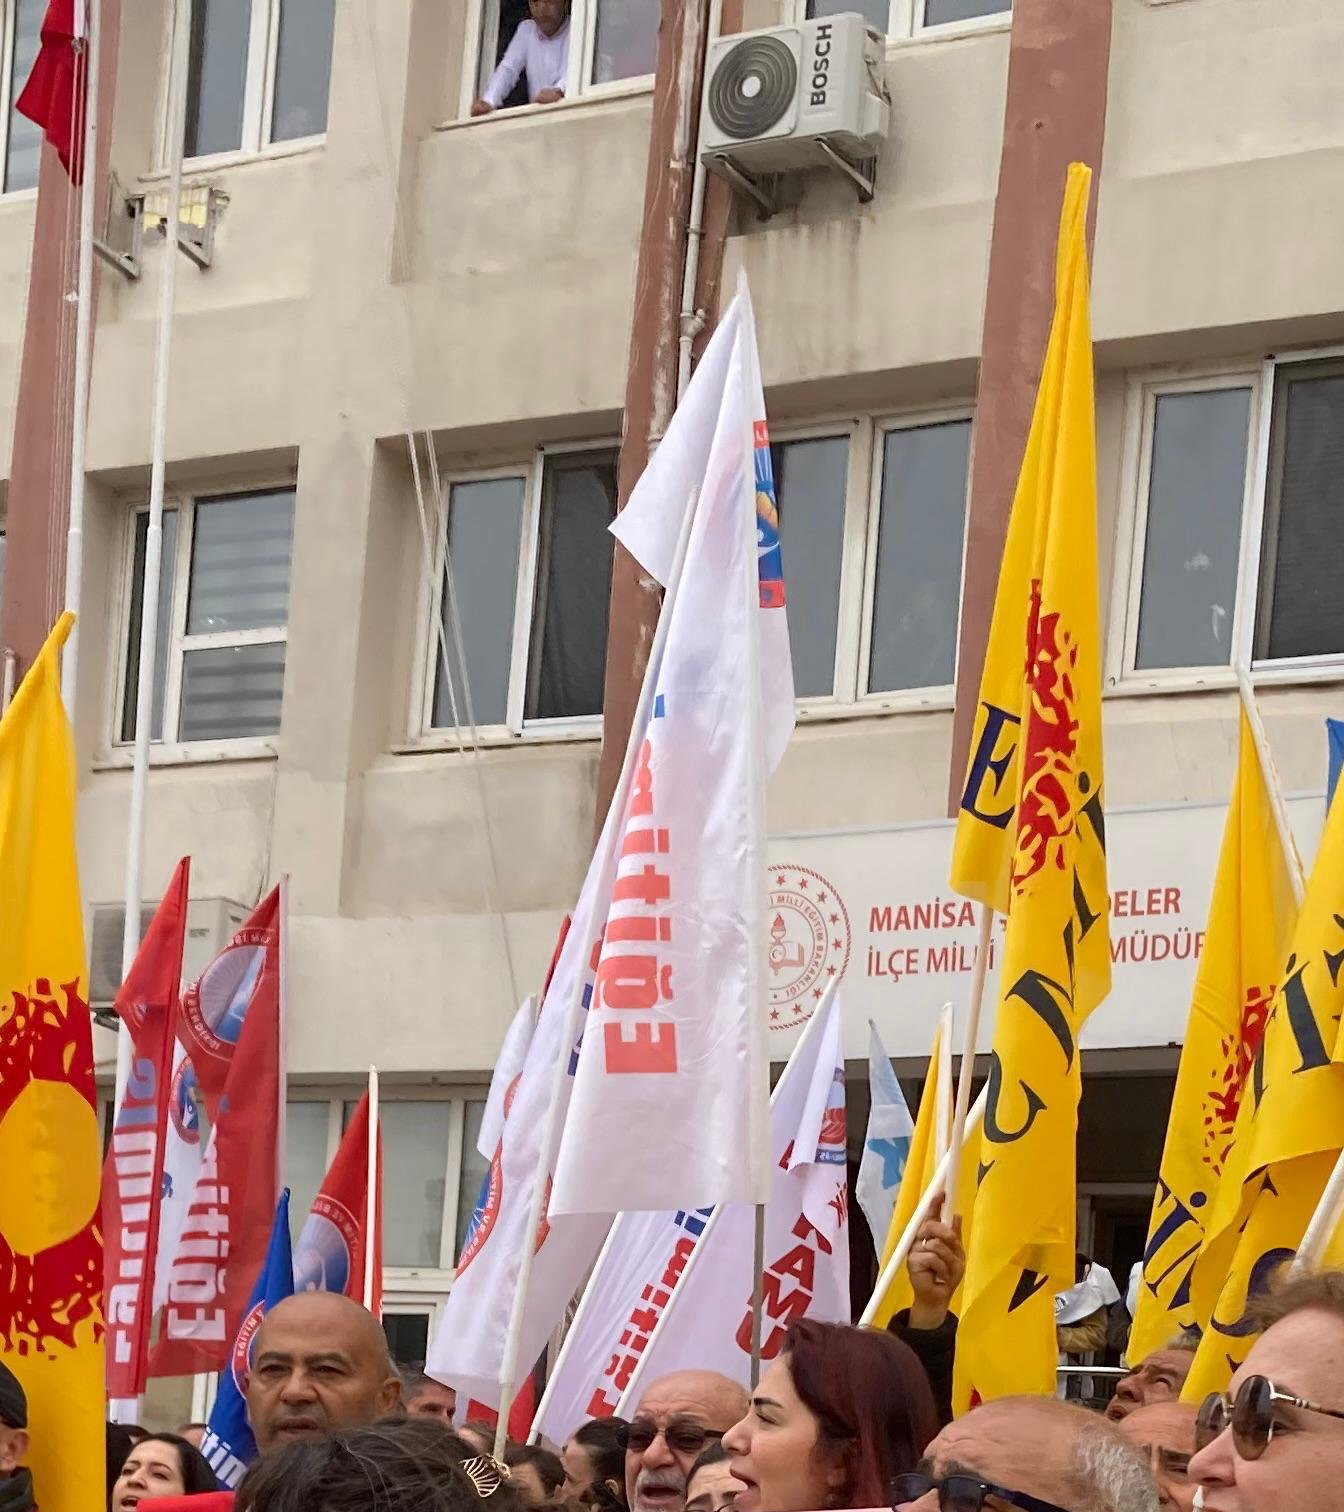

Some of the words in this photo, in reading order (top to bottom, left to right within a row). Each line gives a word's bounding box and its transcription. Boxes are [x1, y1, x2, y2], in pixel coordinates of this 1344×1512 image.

[810, 24, 832, 106] BOSCH
[869, 897, 975, 932] MANİSA
[867, 944, 919, 983] İLÇE
